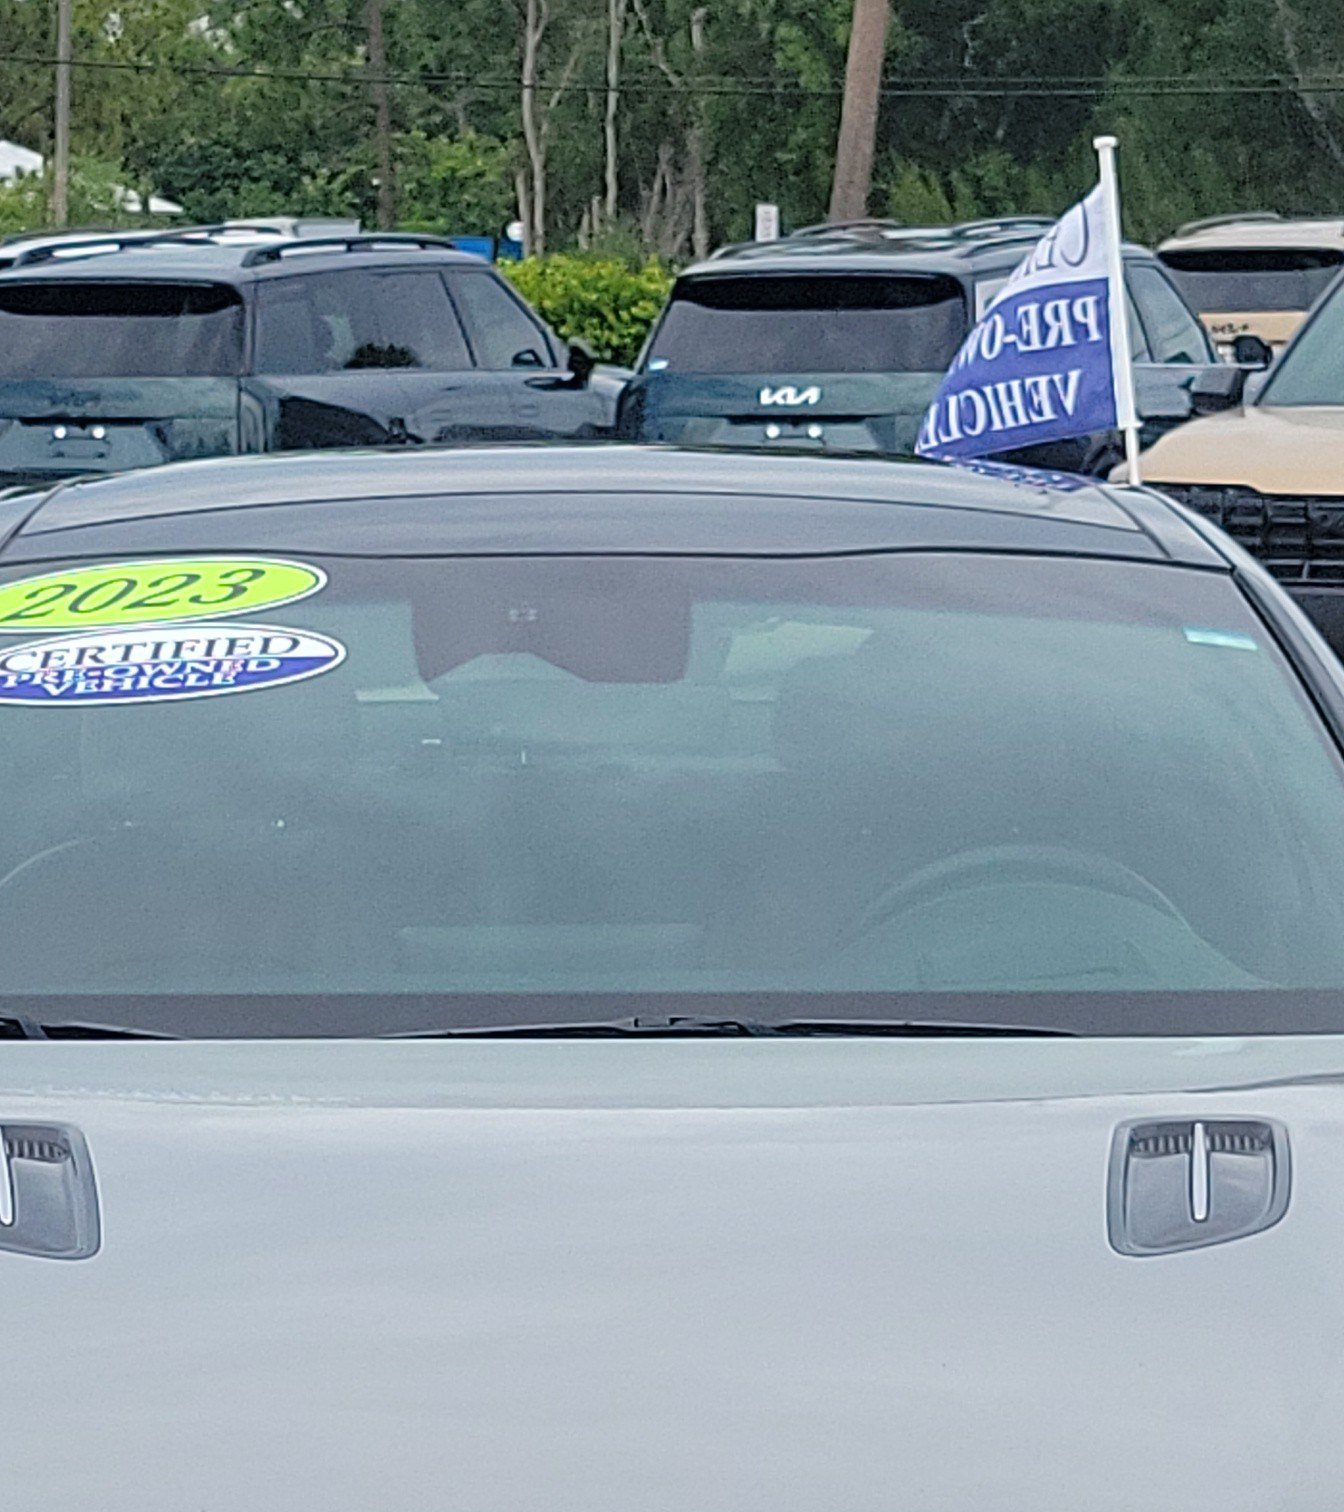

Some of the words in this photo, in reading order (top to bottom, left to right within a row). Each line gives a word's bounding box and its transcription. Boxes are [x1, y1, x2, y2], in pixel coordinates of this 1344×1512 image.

[760, 386, 821, 405] KIA
[0, 636, 300, 673] CERTIFIED
[2, 658, 282, 689] PRE-OWNED
[43, 671, 237, 697] VEHICLE
